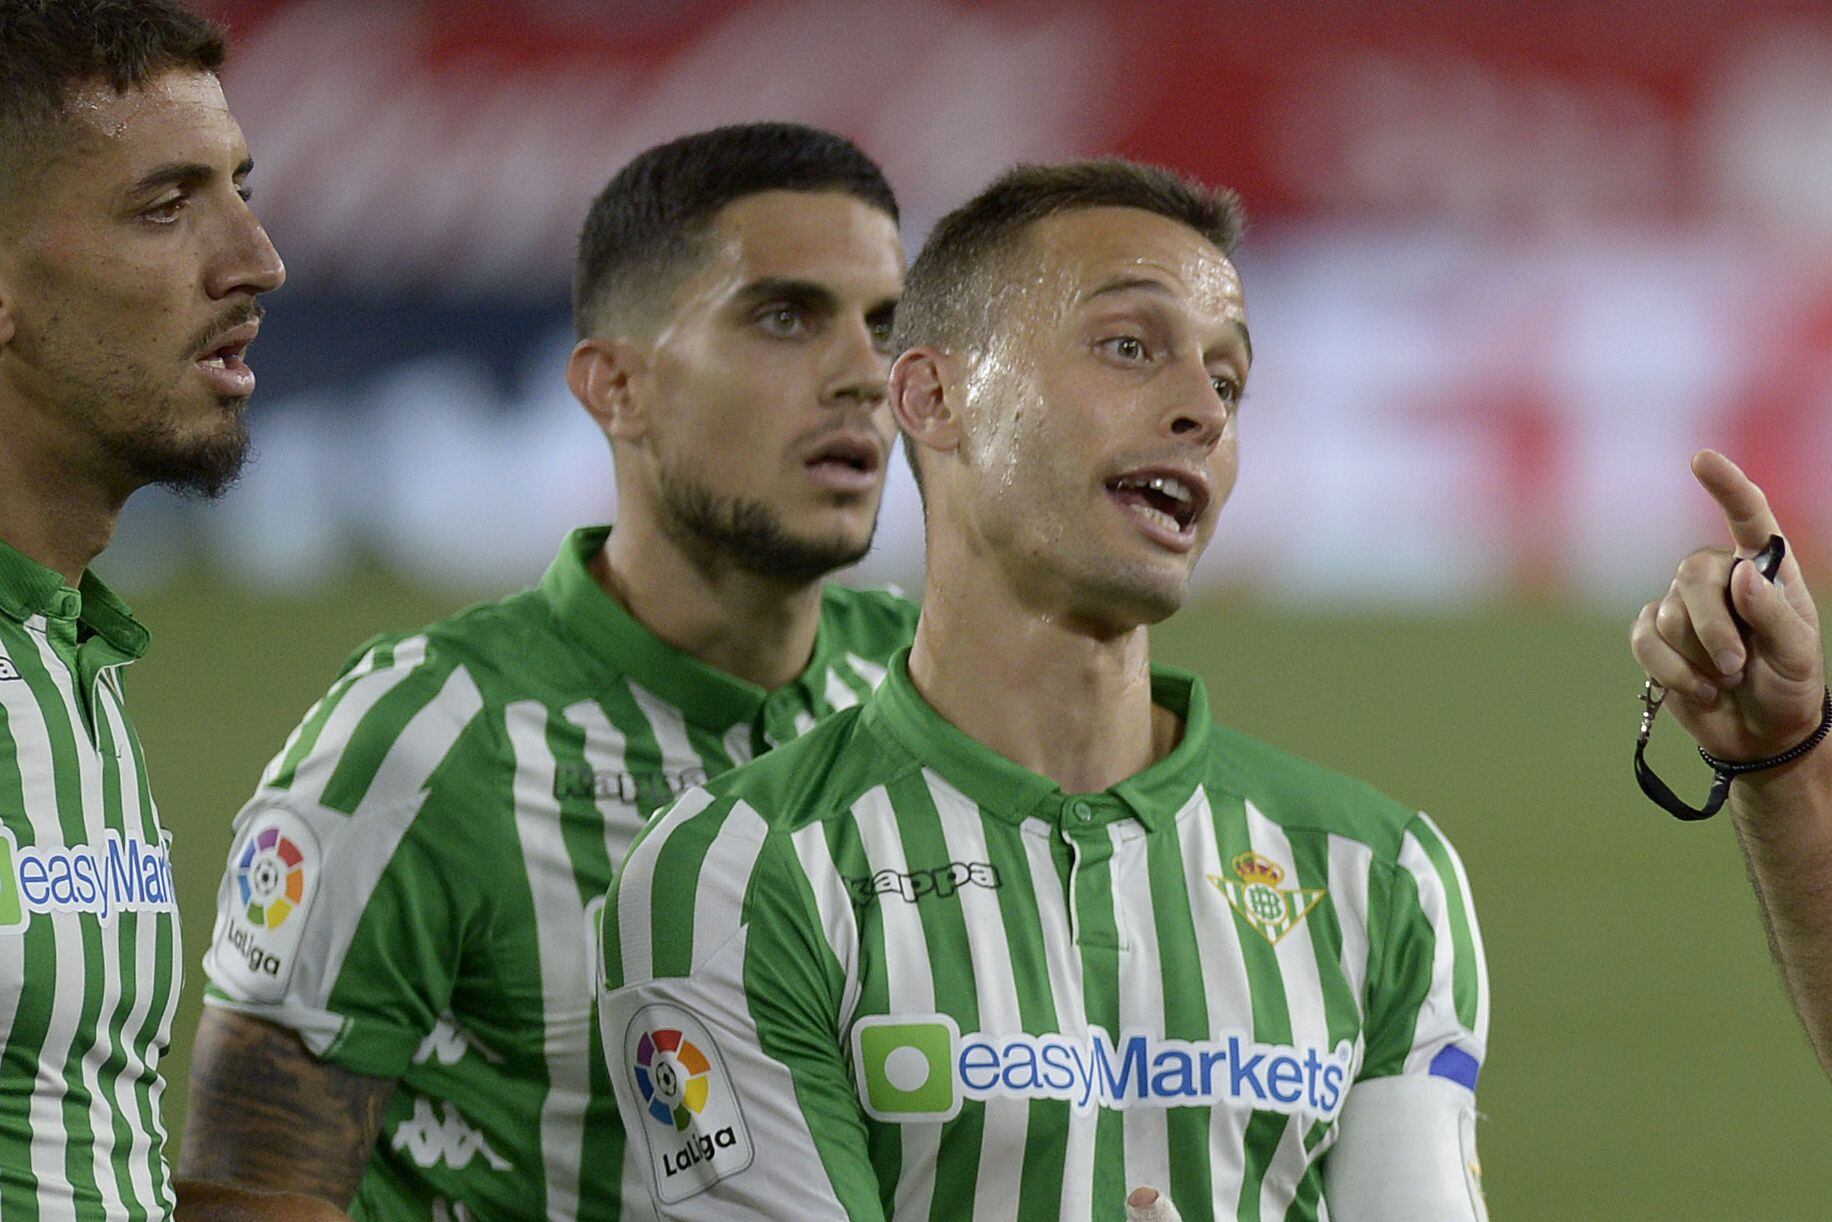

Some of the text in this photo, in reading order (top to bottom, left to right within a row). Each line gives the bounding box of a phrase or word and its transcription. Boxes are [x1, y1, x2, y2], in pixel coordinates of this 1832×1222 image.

[228, 918, 280, 976] LaLiga
[958, 1035, 1343, 1113] easyMarkets
[663, 1126, 737, 1177] LaLiga
